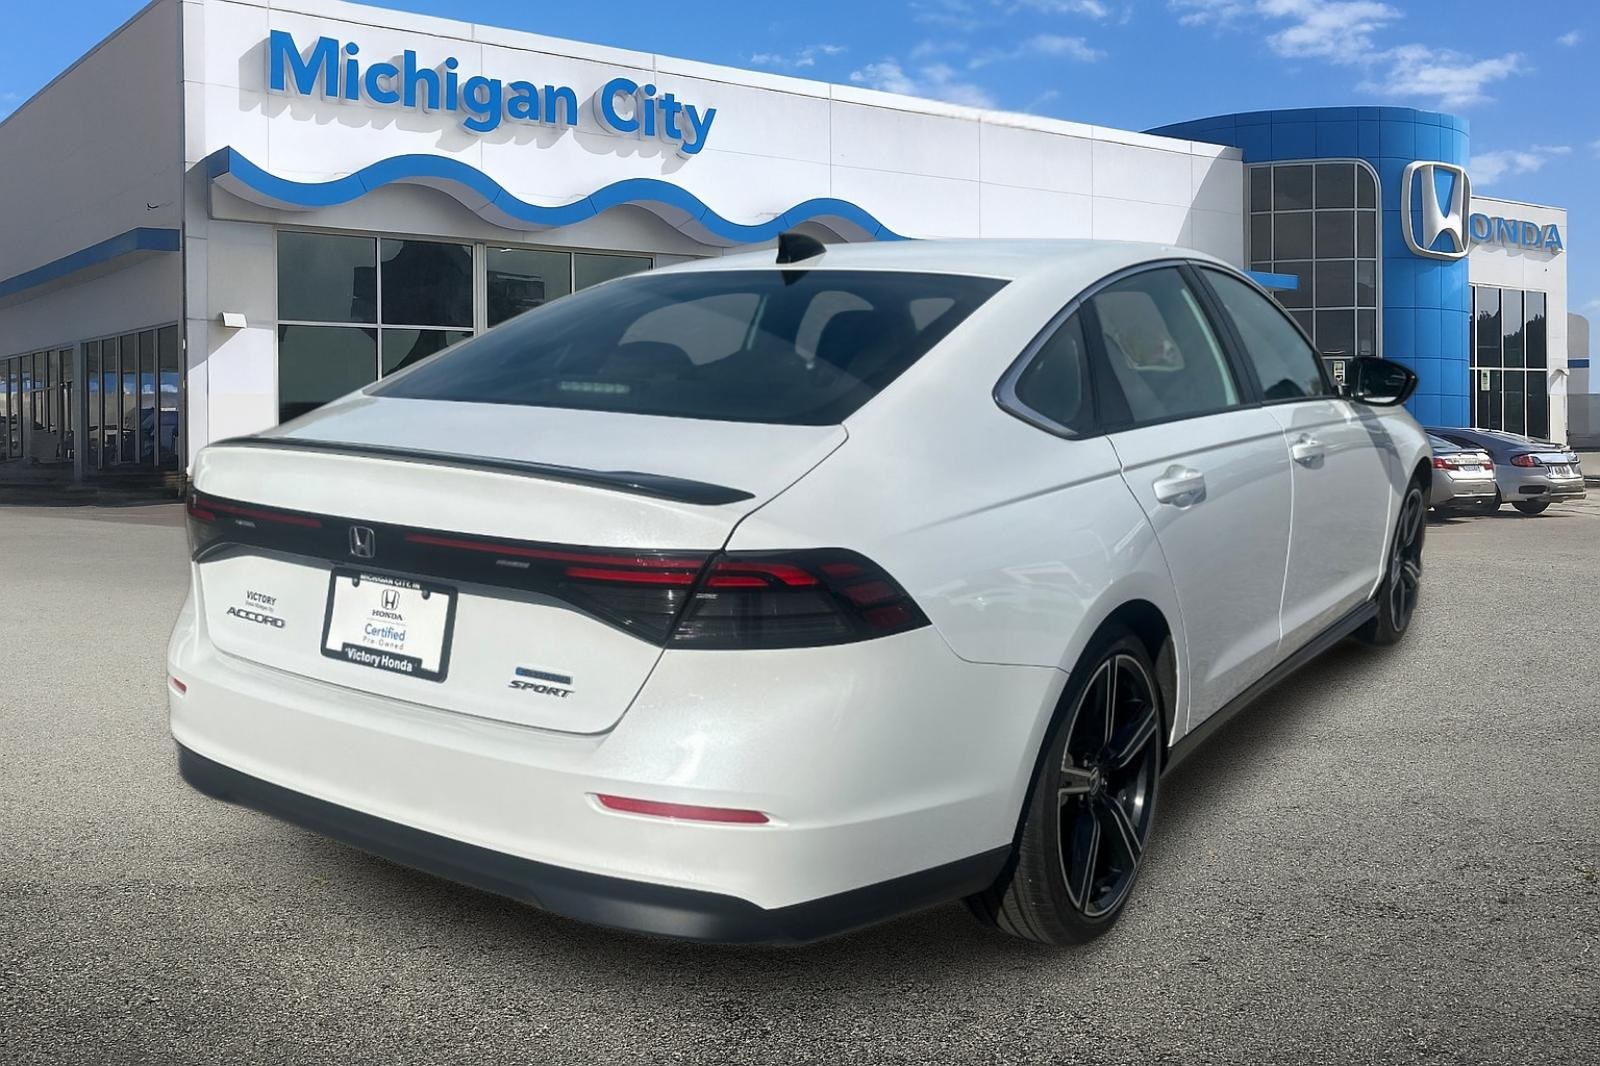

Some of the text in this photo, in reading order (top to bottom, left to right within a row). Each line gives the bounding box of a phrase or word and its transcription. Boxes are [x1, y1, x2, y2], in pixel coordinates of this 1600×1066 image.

[268, 28, 718, 155] Michigan City
[1470, 212, 1564, 251] ONDA
[246, 590, 277, 606] VICTORY
[226, 606, 286, 629] ACCORD
[372, 609, 403, 621] HONDA
[364, 623, 406, 641] Certified
[346, 647, 413, 672] Victory Honda
[508, 679, 576, 698] SPORT
